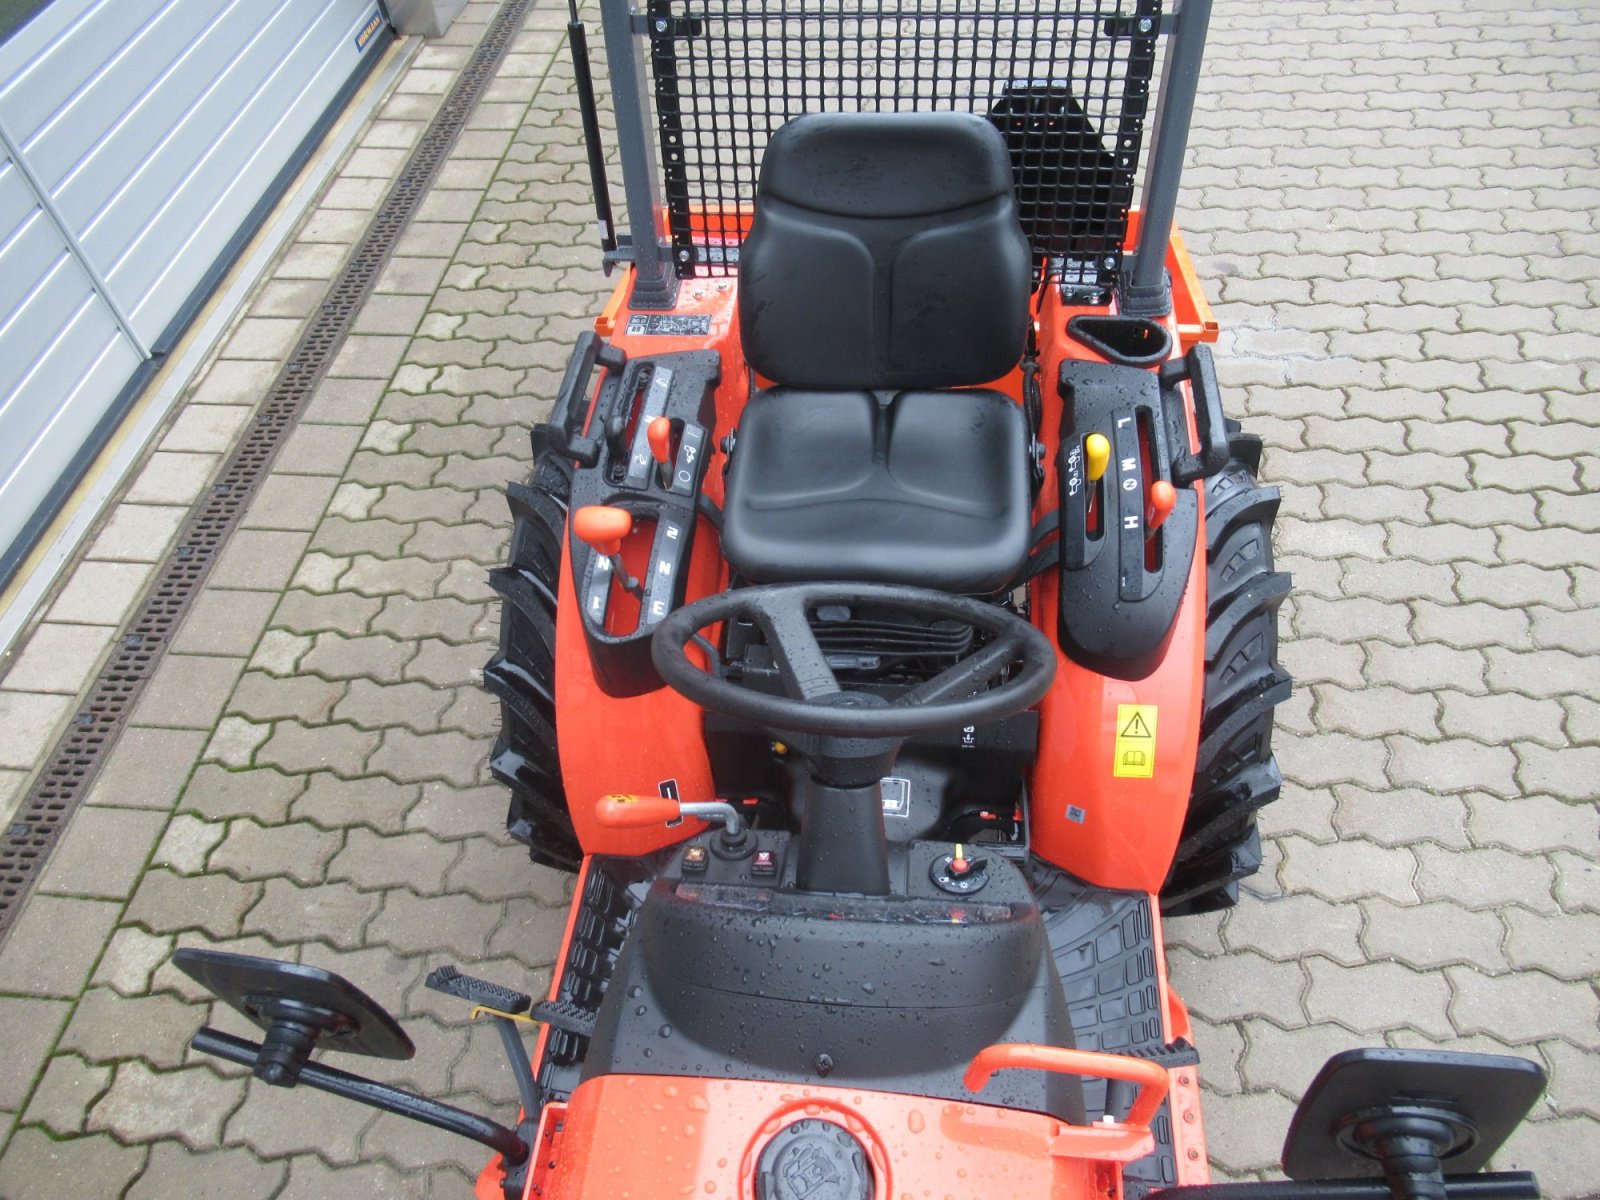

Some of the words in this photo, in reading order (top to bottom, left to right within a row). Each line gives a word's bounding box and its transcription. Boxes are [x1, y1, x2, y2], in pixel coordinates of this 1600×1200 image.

[1117, 416, 1131, 429] L
[1122, 458, 1136, 471] M
[1124, 515, 1138, 529] H
[659, 561, 671, 575] N
